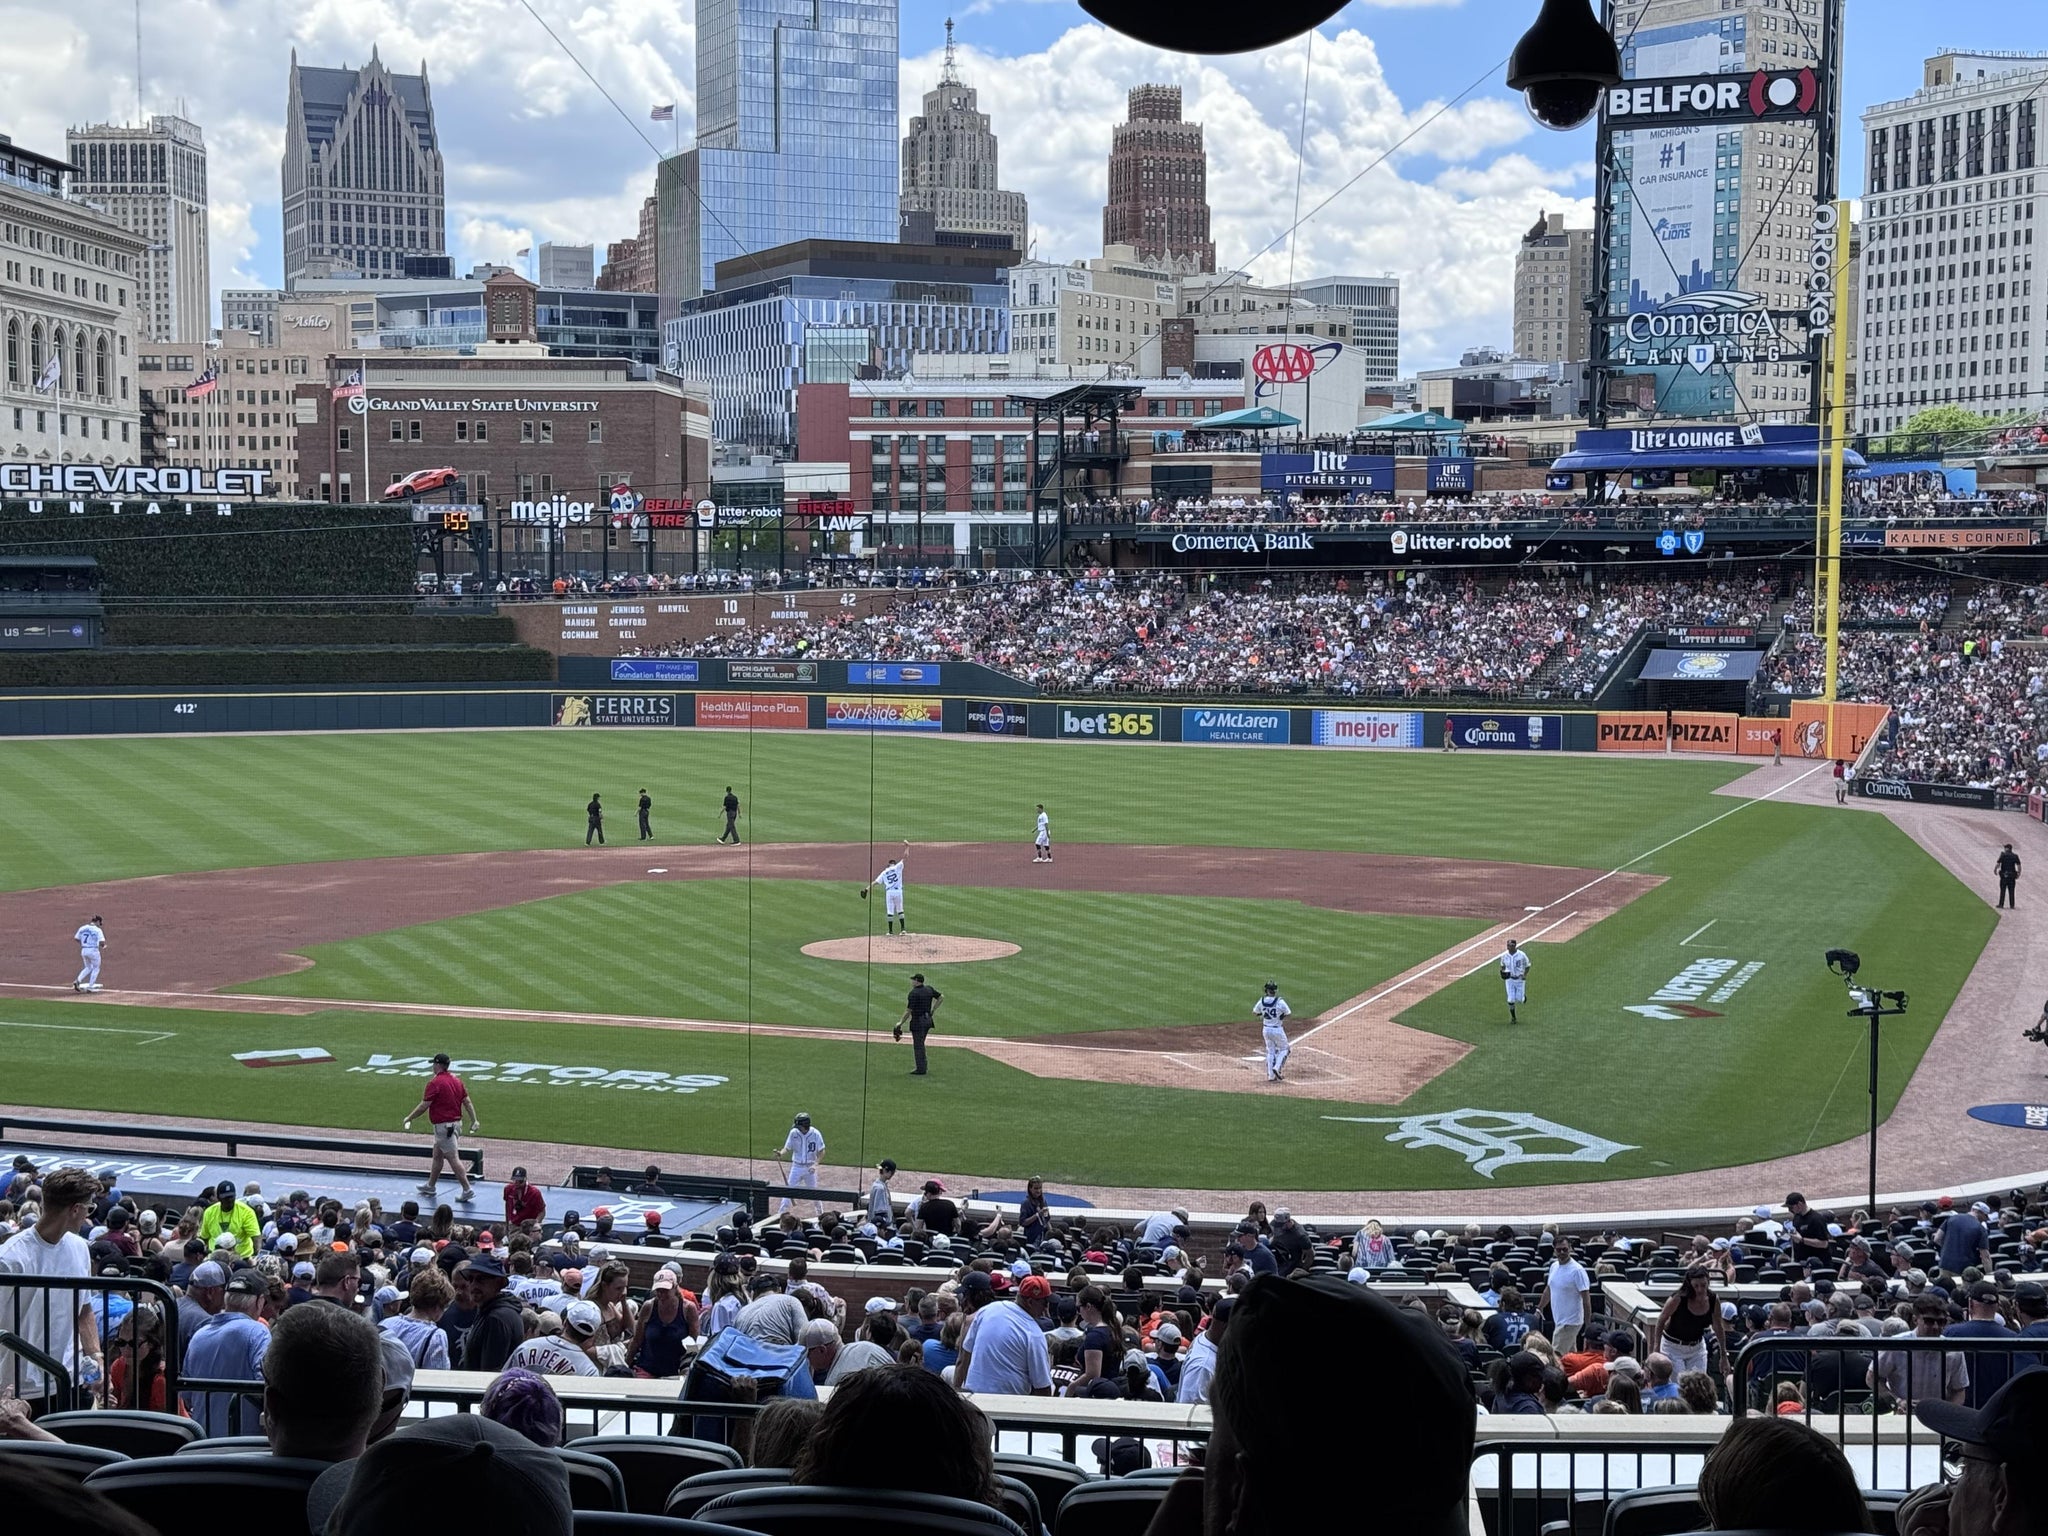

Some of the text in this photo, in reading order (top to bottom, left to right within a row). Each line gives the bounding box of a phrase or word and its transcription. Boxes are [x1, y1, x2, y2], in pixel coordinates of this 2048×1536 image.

[1609, 82, 1741, 115] BELFOR
[1650, 127, 1700, 139] MICHIGANS
[1659, 141, 1685, 169] #1
[1640, 168, 1708, 185] CAR INSURANCE
[1662, 228, 1691, 241] LIONS
[1809, 233, 1837, 339] Rocket
[292, 315, 331, 331] Ashley
[1625, 345, 1780, 366] LANDING
[1256, 344, 1312, 383] AAA
[369, 397, 600, 411] GRAND VALLEY STATE UNIVERSITY
[1630, 430, 1735, 452] Lite LOUNGE
[1312, 450, 1348, 475] Lite
[1, 464, 272, 495] CHEVROLET
[1285, 475, 1373, 485] PITCHER'S PUB
[0, 500, 231, 516] UNTAIN
[511, 494, 595, 528] meijer
[645, 498, 692, 511] BELLE
[444, 512, 469, 531] 1:55
[650, 514, 686, 527] TIRE
[819, 515, 855, 530] LAW
[1264, 532, 1314, 550] Bank
[1890, 532, 2024, 544] KALINES CORNER
[723, 599, 738, 613] 10
[783, 594, 796, 608] 11
[839, 592, 857, 606] 42
[658, 604, 690, 613] HARWELL
[770, 610, 809, 619] ANDERSON
[715, 617, 746, 626] LEYLAND
[619, 630, 637, 639] KELL
[1668, 627, 1688, 636] PLAY
[1680, 636, 1746, 644] LOTTERY GAMES
[614, 671, 695, 680] Foundation Restoration
[174, 703, 198, 713] 412'
[595, 697, 671, 714] FERRIS
[701, 701, 734, 712] Health
[734, 701, 776, 712] Alliance
[835, 701, 898, 724] Surfside
[596, 715, 670, 723] STATE UNIVERSITY
[968, 712, 987, 722] PEPSI
[1006, 715, 1026, 724] PEPSI
[1064, 710, 1153, 735] bet365
[1217, 712, 1278, 729] McLaren
[1210, 731, 1264, 741] HEALTH CARE
[1335, 716, 1399, 742] meijer
[1465, 728, 1516, 745] Corona
[1601, 724, 1664, 742] PIZZA!
[1672, 723, 1730, 743] PIZZA!
[83, 933, 90, 944] 7
[1647, 958, 1738, 1001] VICTORS
[467, 1074, 702, 1094] SOLUTIONS
